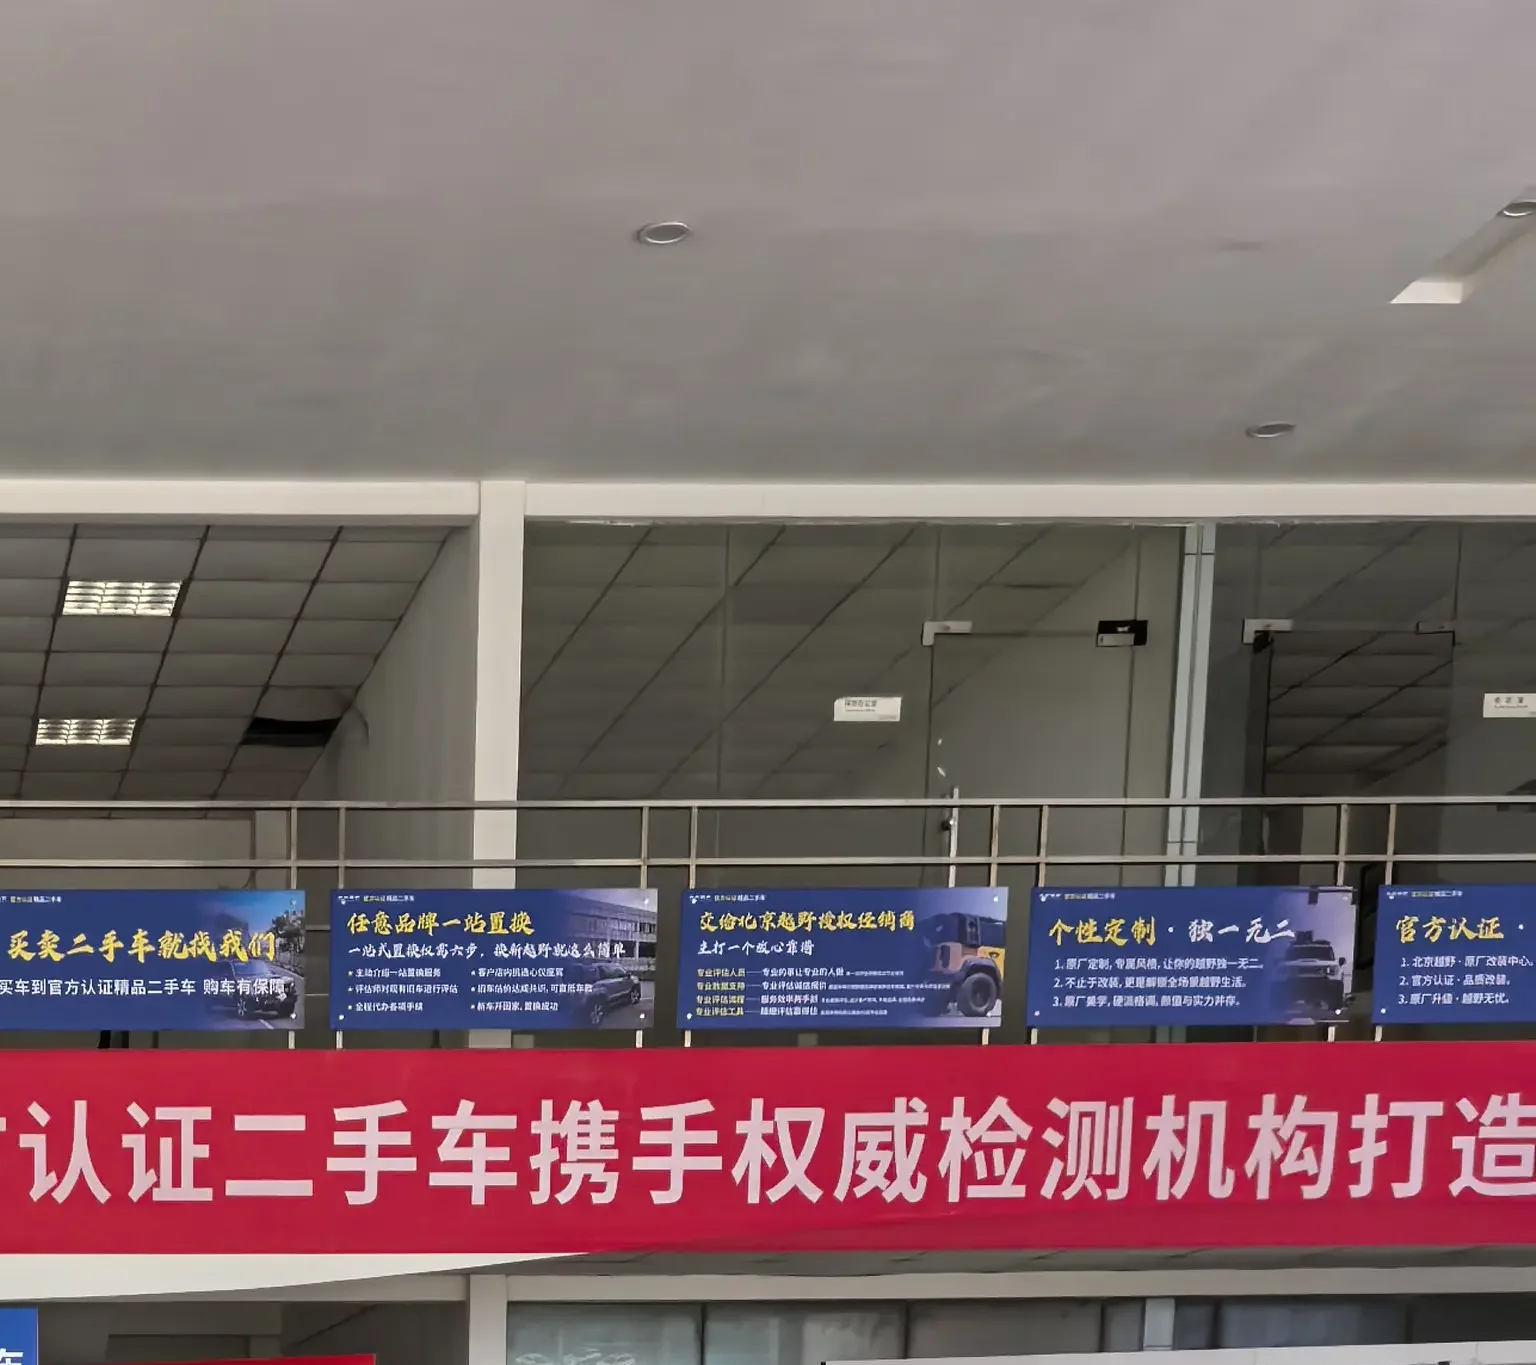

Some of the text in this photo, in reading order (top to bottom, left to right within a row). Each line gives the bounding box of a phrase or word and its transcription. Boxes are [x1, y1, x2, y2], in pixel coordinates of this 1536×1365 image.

[346, 911, 537, 937] 任意品牌一站置换
[699, 911, 915, 933] 交给北京越野授权经销商
[7, 928, 277, 964] 买卖二手车就找我们
[203, 978, 286, 997] 购车有保障
